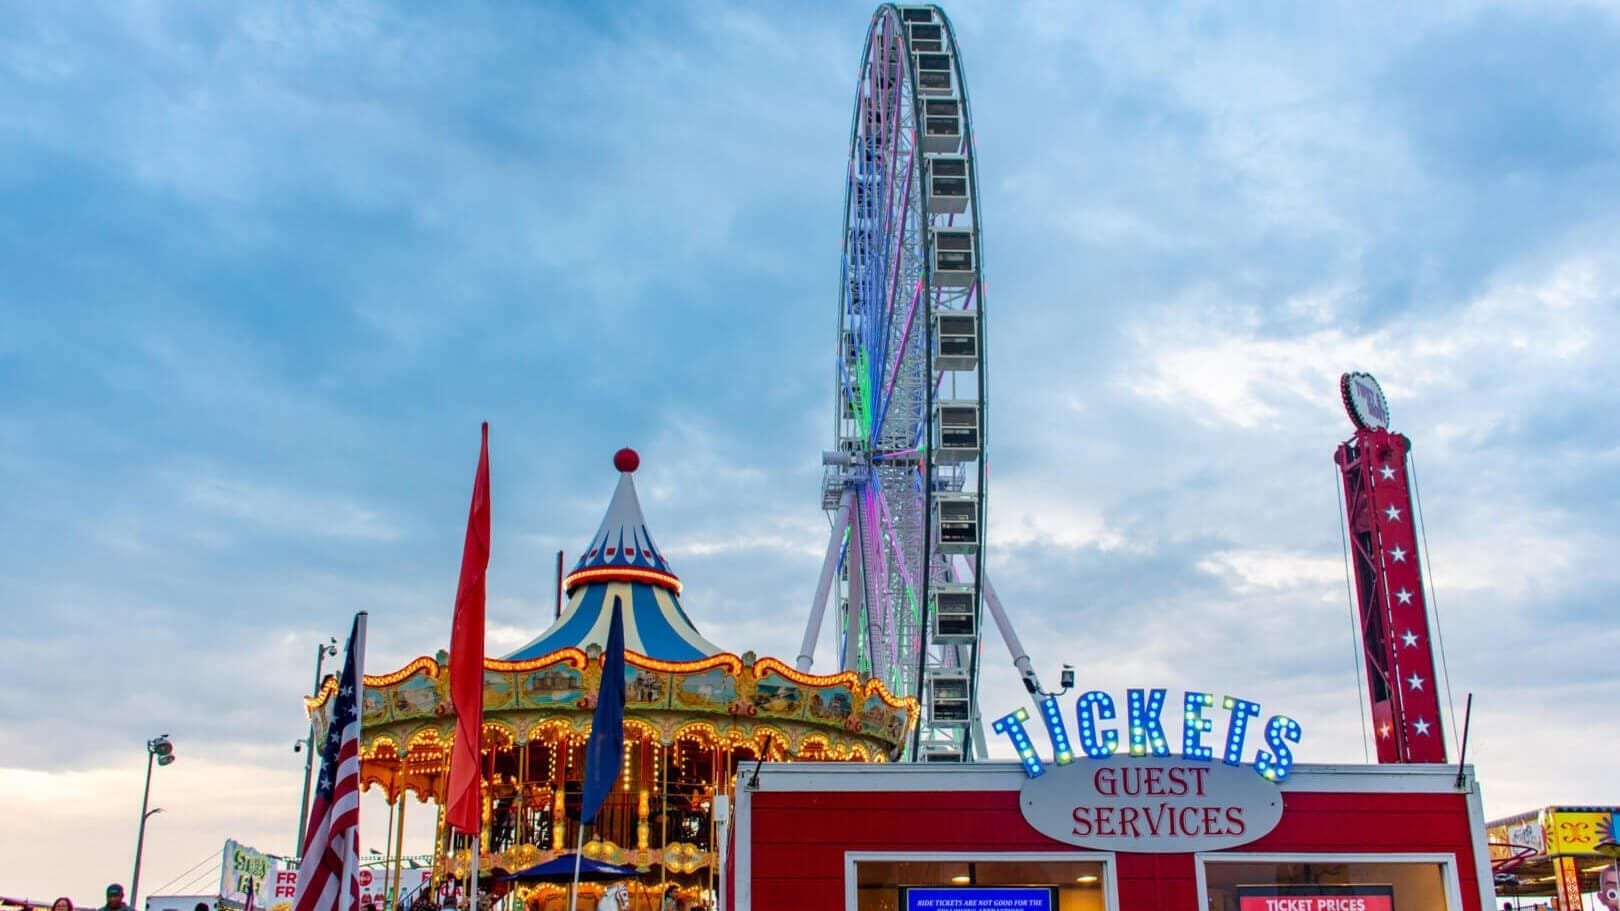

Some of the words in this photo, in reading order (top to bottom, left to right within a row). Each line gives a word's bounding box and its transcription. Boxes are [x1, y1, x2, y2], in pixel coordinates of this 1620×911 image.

[992, 688, 1302, 782] TICKETS
[1094, 767, 1210, 797] GUEST
[1071, 803, 1246, 838] SERVICES
[917, 899, 933, 907] RIDE
[935, 899, 963, 907] TICKETS
[963, 899, 977, 907] ARE
[978, 899, 993, 907] NOT
[993, 899, 1013, 907] GOOD
[1013, 899, 1028, 907] FOR
[1029, 899, 1042, 907] THE
[1266, 899, 1313, 911] TICKET
[1317, 899, 1366, 911] PRICES
